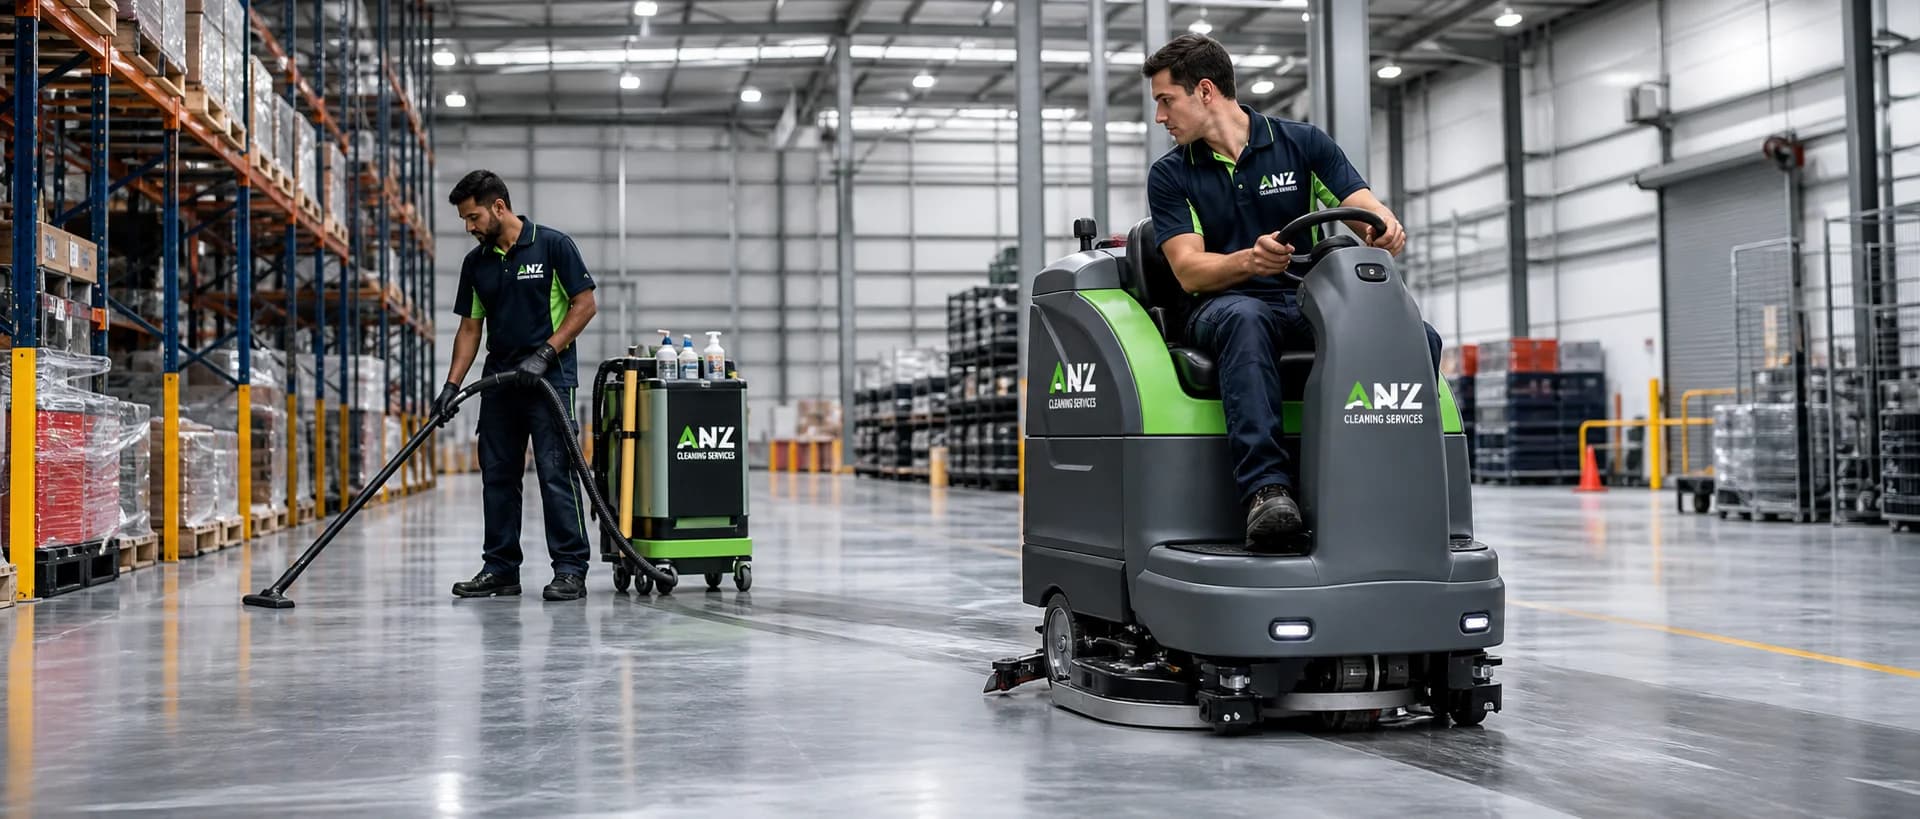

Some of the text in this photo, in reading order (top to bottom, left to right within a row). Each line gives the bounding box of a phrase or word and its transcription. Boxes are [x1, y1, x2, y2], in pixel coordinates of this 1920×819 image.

[1259, 171, 1296, 189] ANZ
[517, 263, 544, 275] ANZ
[1049, 361, 1096, 394] ANZ
[1344, 380, 1423, 410] ANZ
[1344, 414, 1423, 424] CLEANING SERVICES
[677, 425, 735, 449] ANZ
[707, 451, 735, 460] SERVICES
